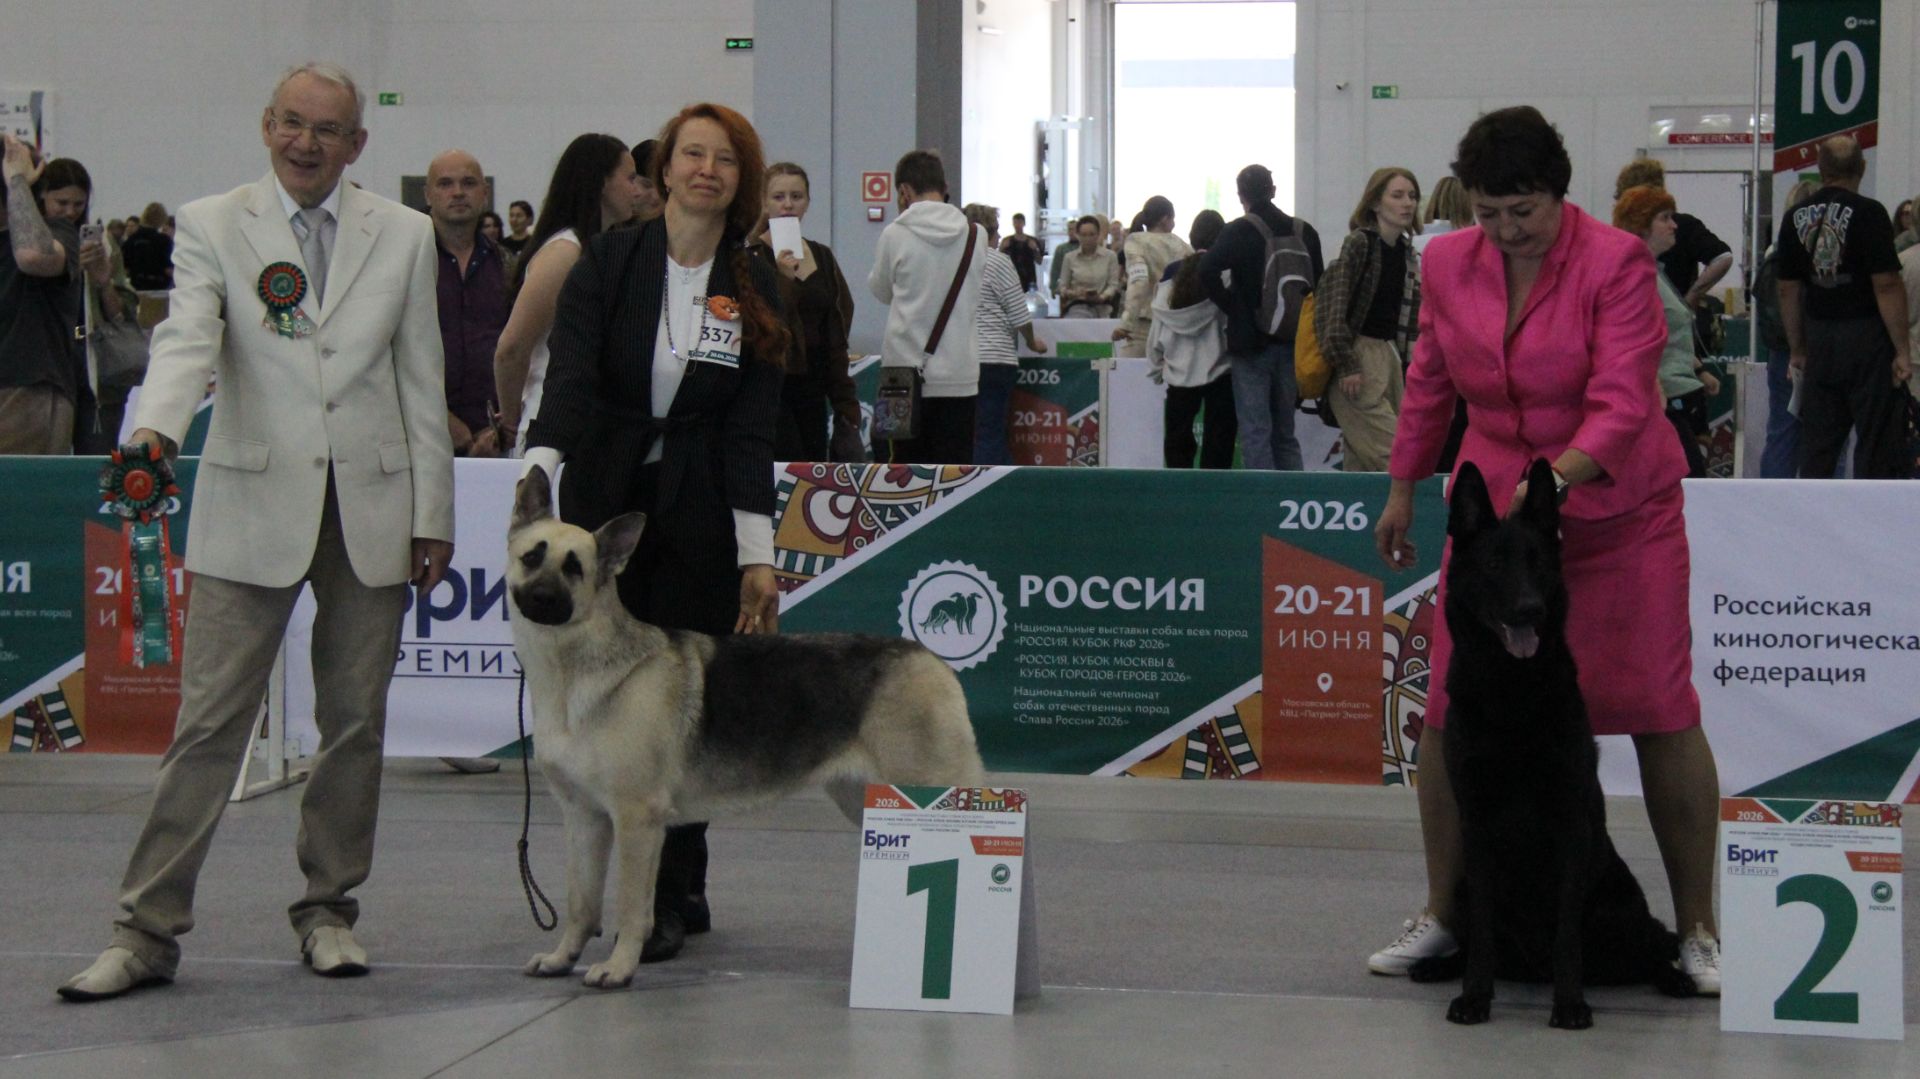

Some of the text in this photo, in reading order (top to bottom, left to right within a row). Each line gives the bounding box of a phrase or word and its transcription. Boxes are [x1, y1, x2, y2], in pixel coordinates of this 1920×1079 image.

[1791, 39, 1866, 116] 10
[1676, 133, 1746, 144] CONFERENCE
[700, 326, 733, 344] 337
[1016, 369, 1061, 385] 2026
[1013, 410, 1062, 426] 20-21
[1278, 499, 1369, 532] 2026
[1019, 574, 1205, 612] РОССИЯ
[1273, 584, 1371, 617] 20-21
[404, 567, 510, 639] ри
[1713, 593, 1872, 617] Российская
[1013, 622, 1249, 639] Национальные выставки собак всех пород
[1278, 628, 1371, 650] ИЮНЯ
[1072, 638, 1110, 649] КУБОК
[1113, 638, 1136, 650] РКФ
[1713, 632, 1920, 651] кинологическа
[1072, 655, 1110, 667] КУБОК
[1113, 657, 1164, 668] МОСКВЫ
[1166, 658, 1176, 669] &
[1019, 668, 1057, 680] КУБОК
[1060, 669, 1158, 681] ГОРОДОВ-ГЕРОЕВ
[1712, 658, 1867, 688] федерация
[1013, 686, 1161, 701] Национальный чемпионат
[1013, 701, 1170, 715] собак отечественных пород
[1055, 715, 1095, 726] России
[875, 798, 900, 808] 2026
[1737, 810, 1764, 822] 2026
[864, 830, 911, 850] Брит
[1727, 844, 1778, 866] Брит
[905, 857, 960, 1001] 1
[1773, 873, 1860, 1025] 2
